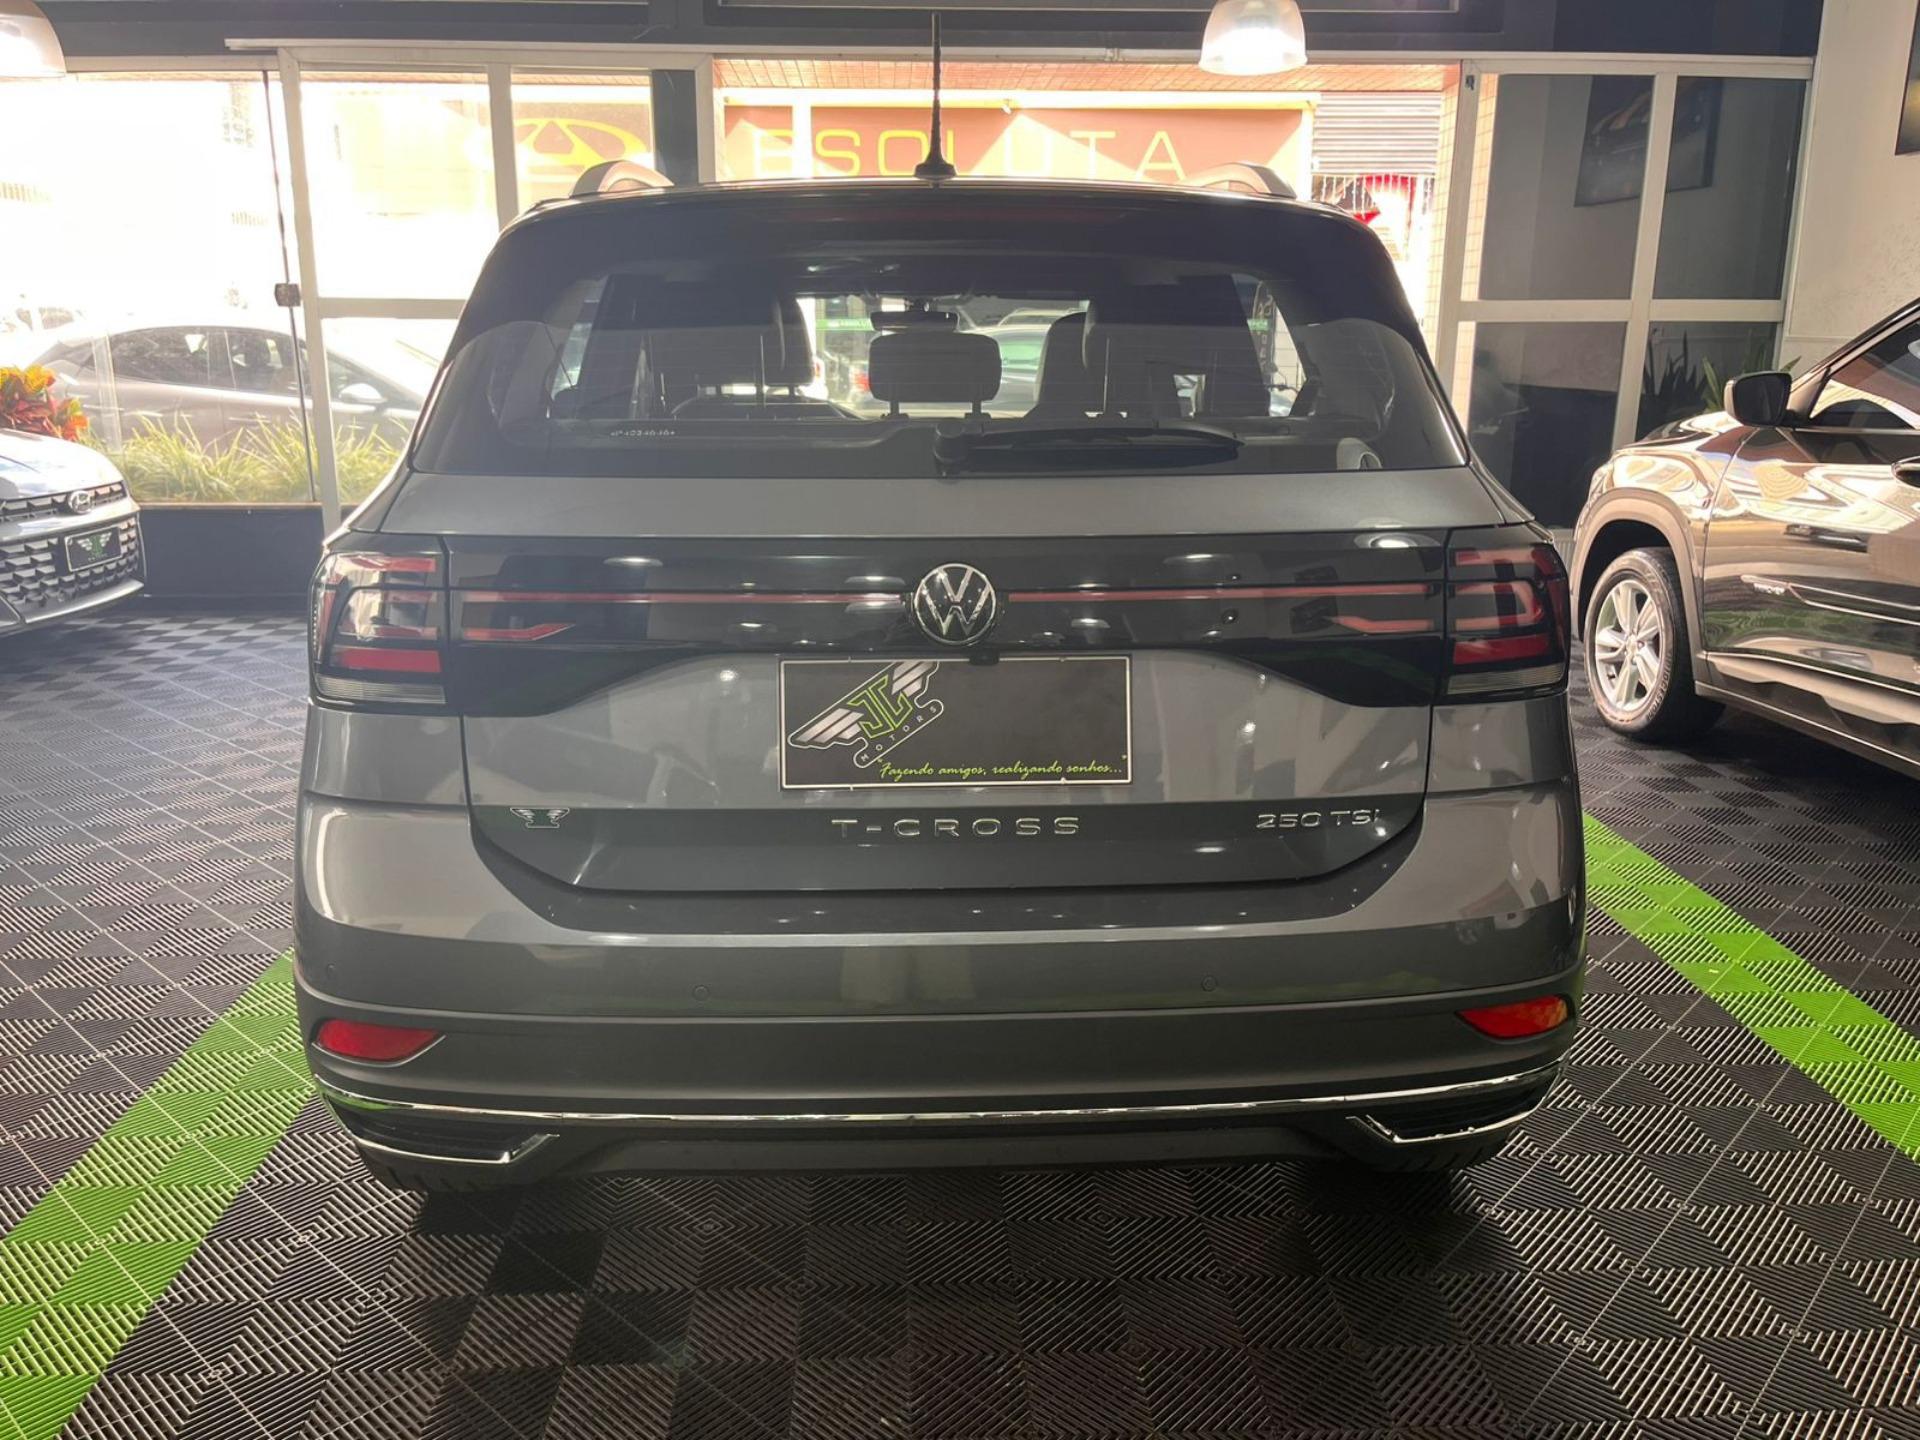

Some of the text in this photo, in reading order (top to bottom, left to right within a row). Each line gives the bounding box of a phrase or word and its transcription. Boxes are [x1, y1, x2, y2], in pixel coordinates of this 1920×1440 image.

[860, 705, 937, 762] MOTORS
[938, 764, 987, 780] amigos,
[991, 760, 1062, 780] realizando
[831, 816, 1080, 838] T-CROSS
[1256, 812, 1321, 829] 250
